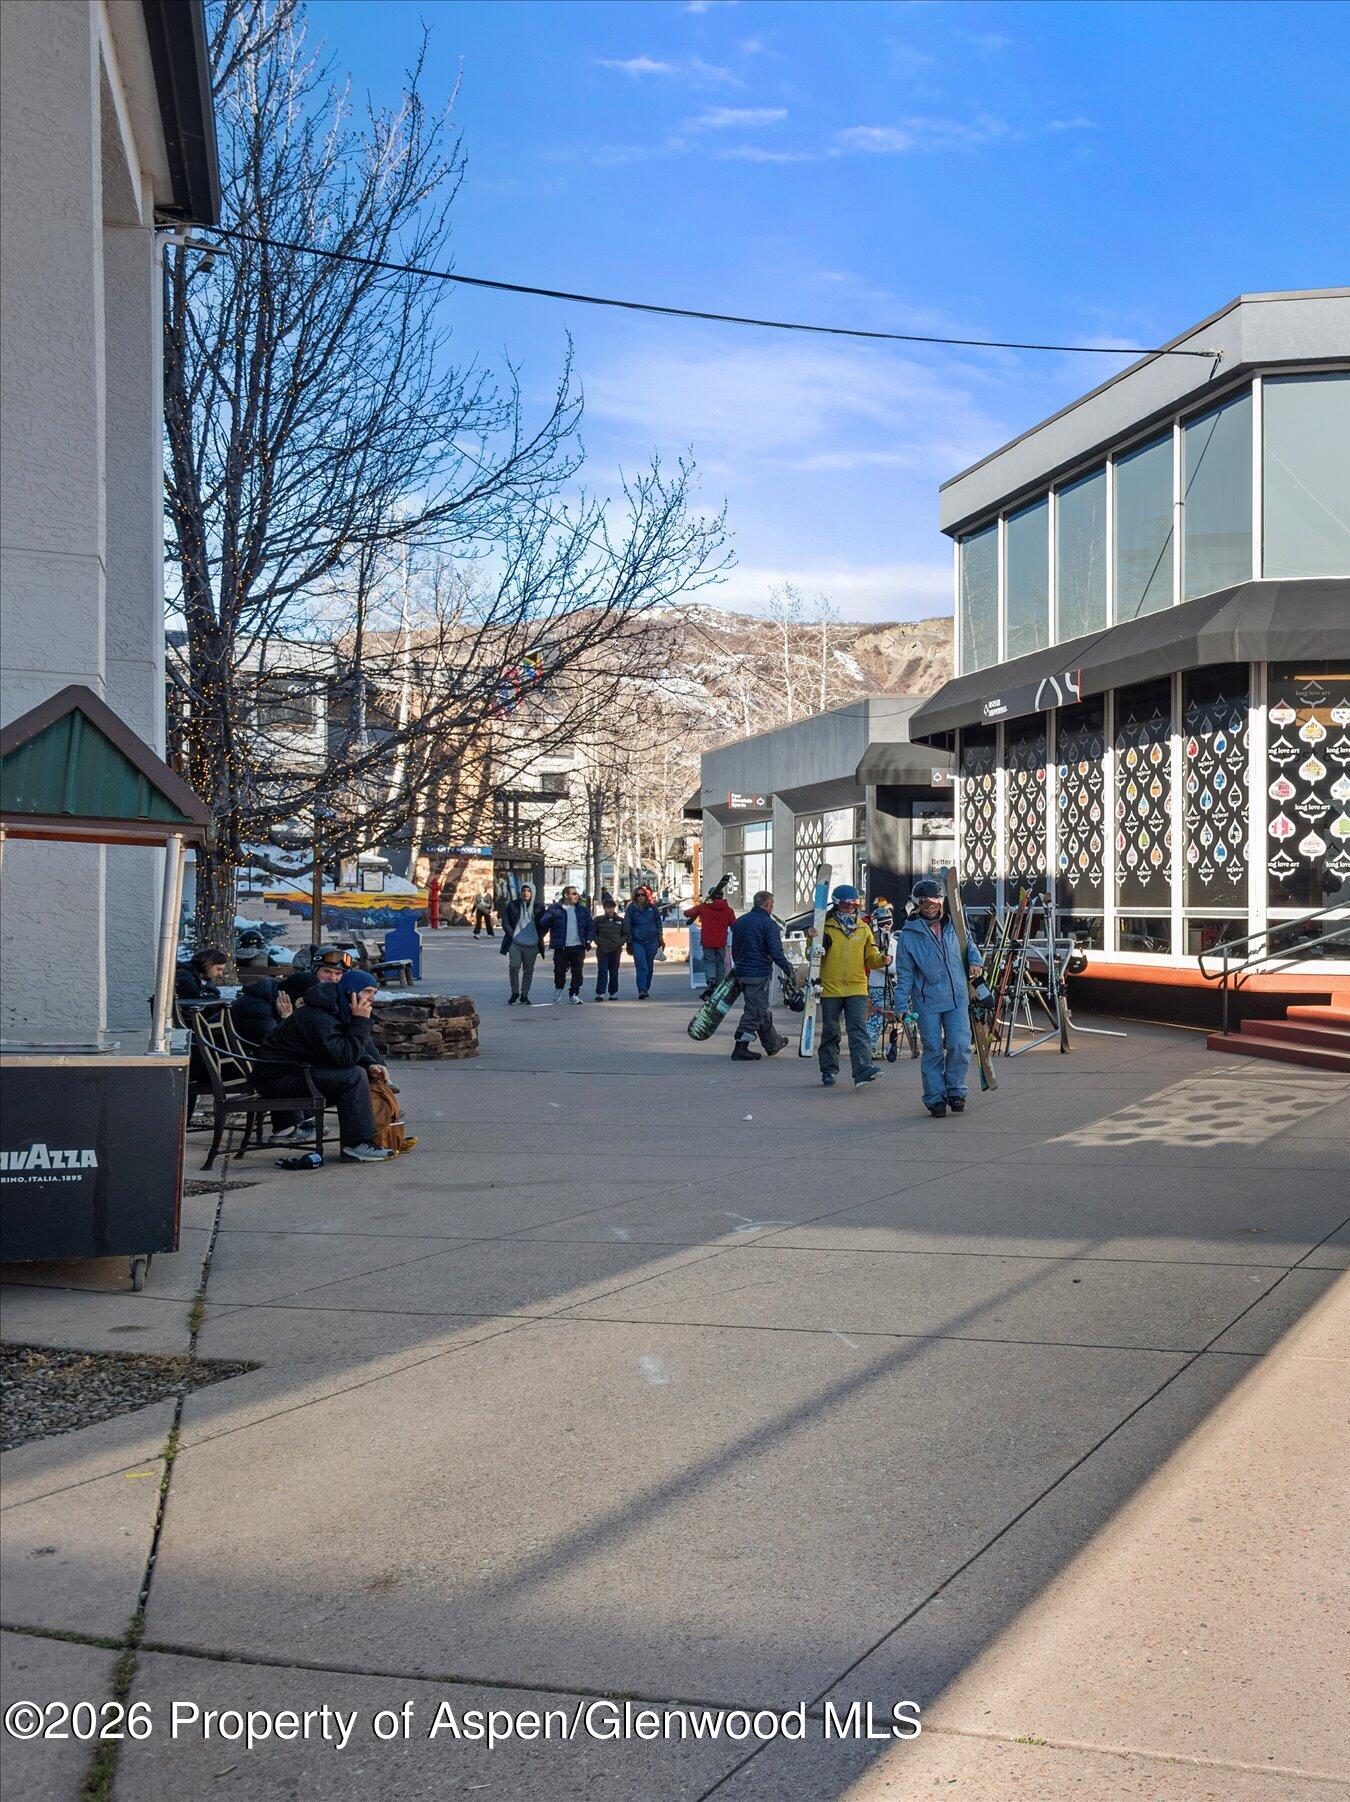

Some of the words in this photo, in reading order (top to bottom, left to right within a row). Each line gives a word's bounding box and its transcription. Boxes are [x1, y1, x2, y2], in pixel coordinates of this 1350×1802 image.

[1295, 690, 1309, 698] long
[1295, 804, 1308, 812] long
[1326, 861, 1339, 869] long
[62, 1174, 83, 1182] 1895
